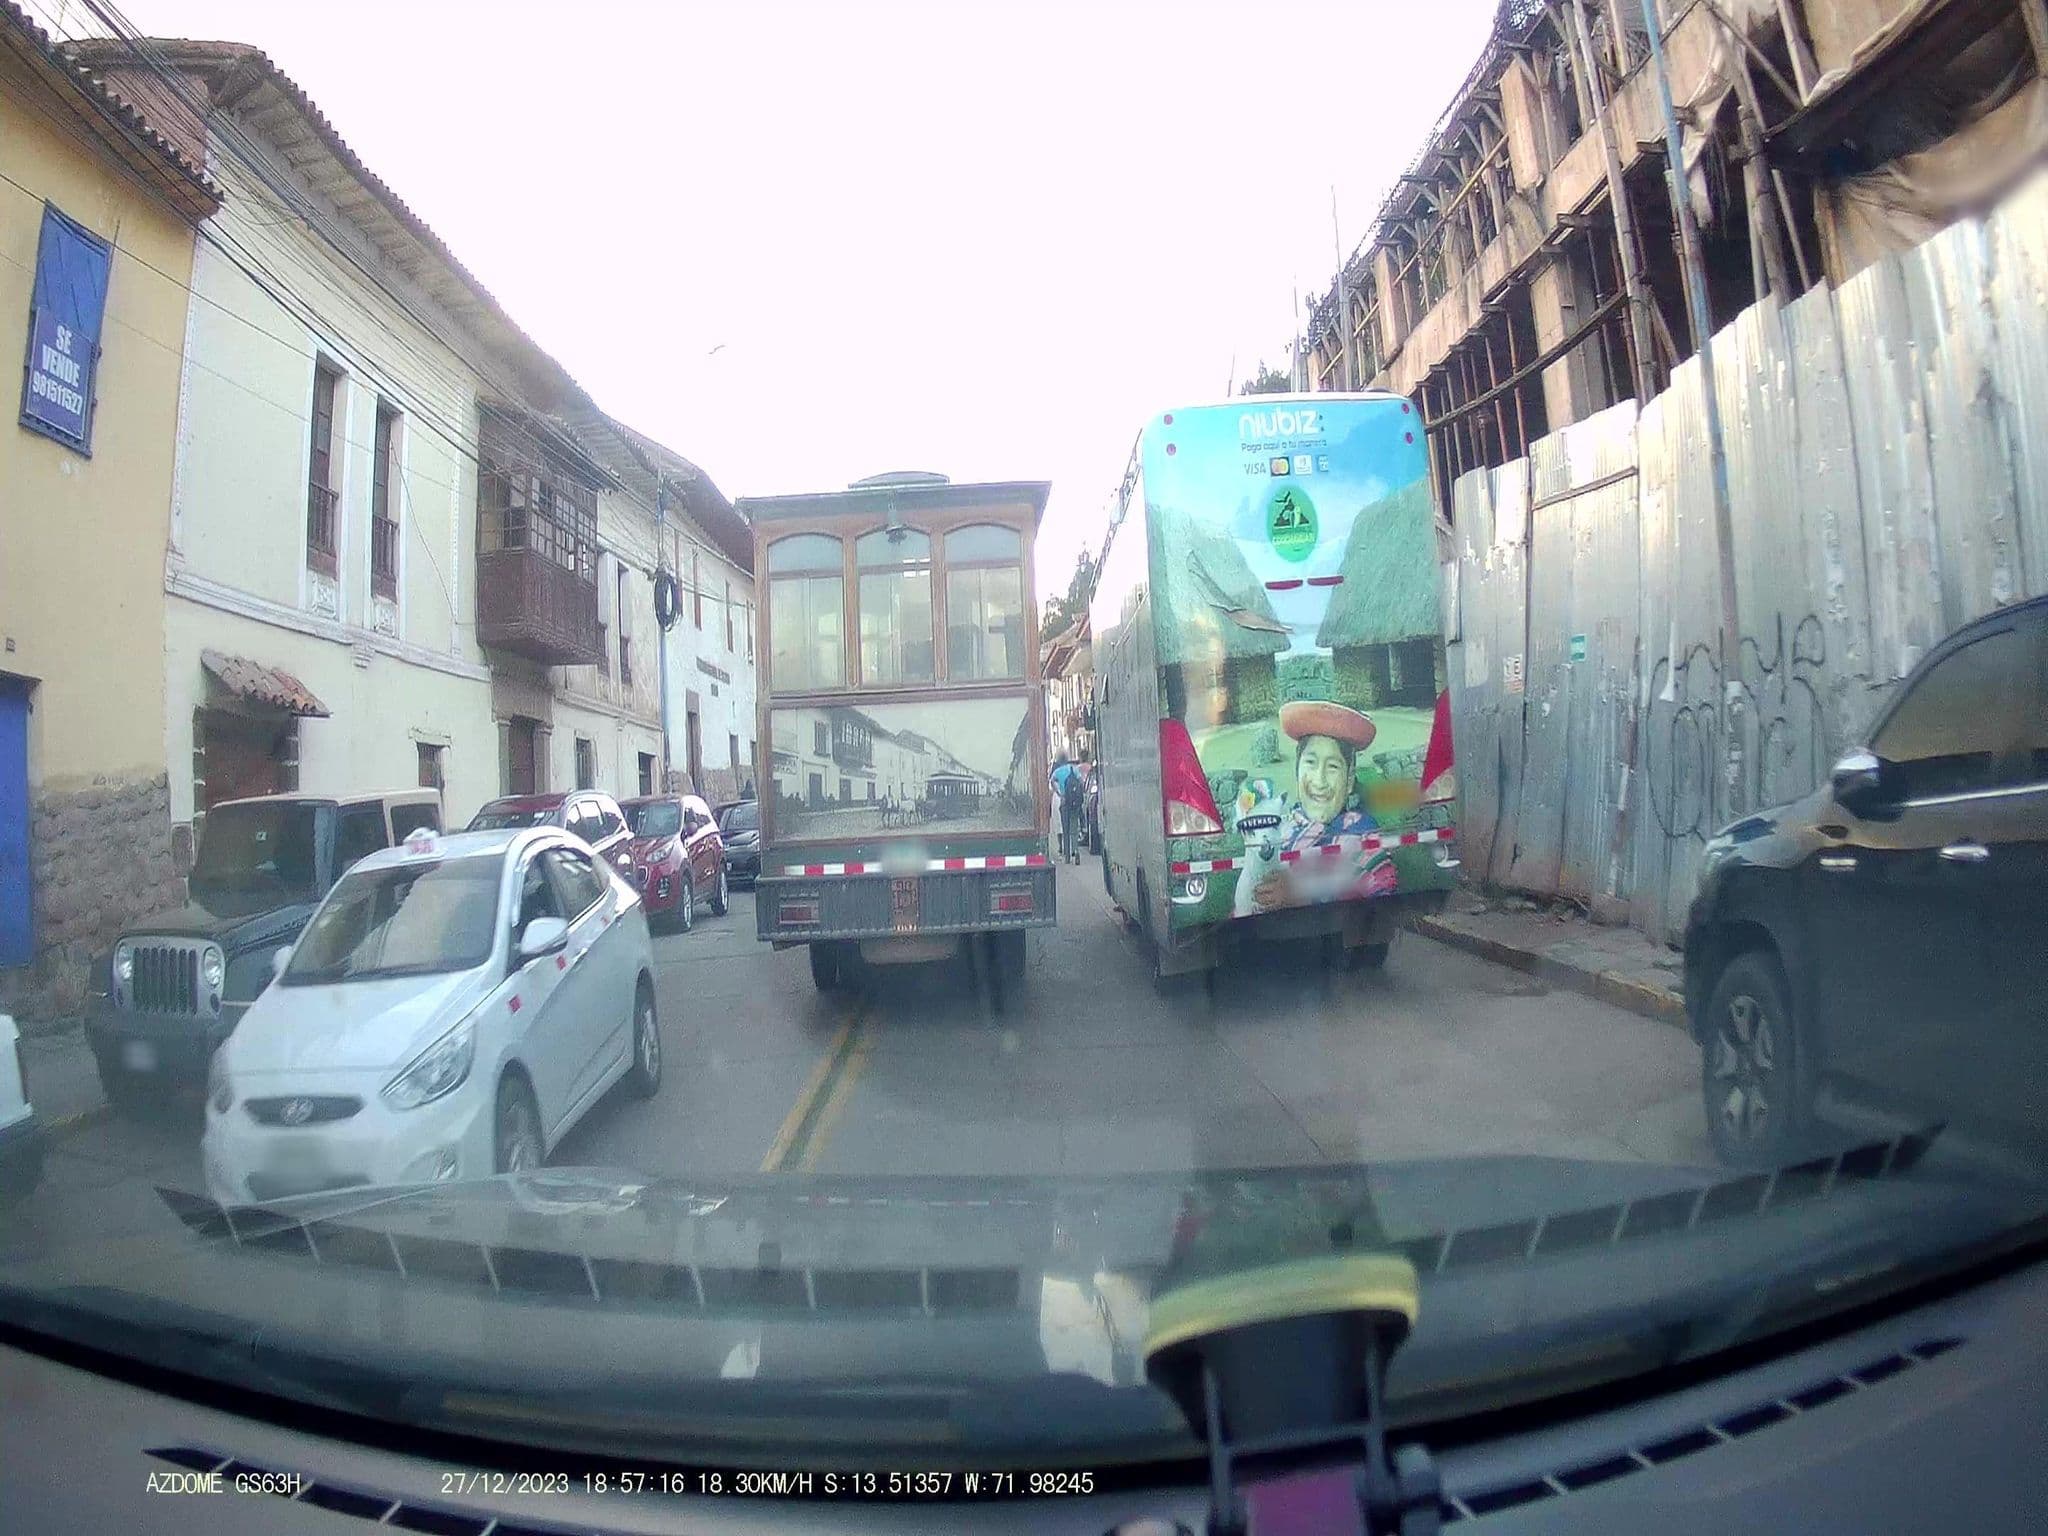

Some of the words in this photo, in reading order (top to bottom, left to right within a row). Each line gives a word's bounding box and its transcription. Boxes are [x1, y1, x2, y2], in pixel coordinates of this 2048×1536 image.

[56, 325, 72, 354] SE
[42, 344, 80, 387] VENDE
[33, 371, 83, 415] 981511527
[1241, 443, 1262, 453] Paga
[1243, 461, 1267, 475] VISA
